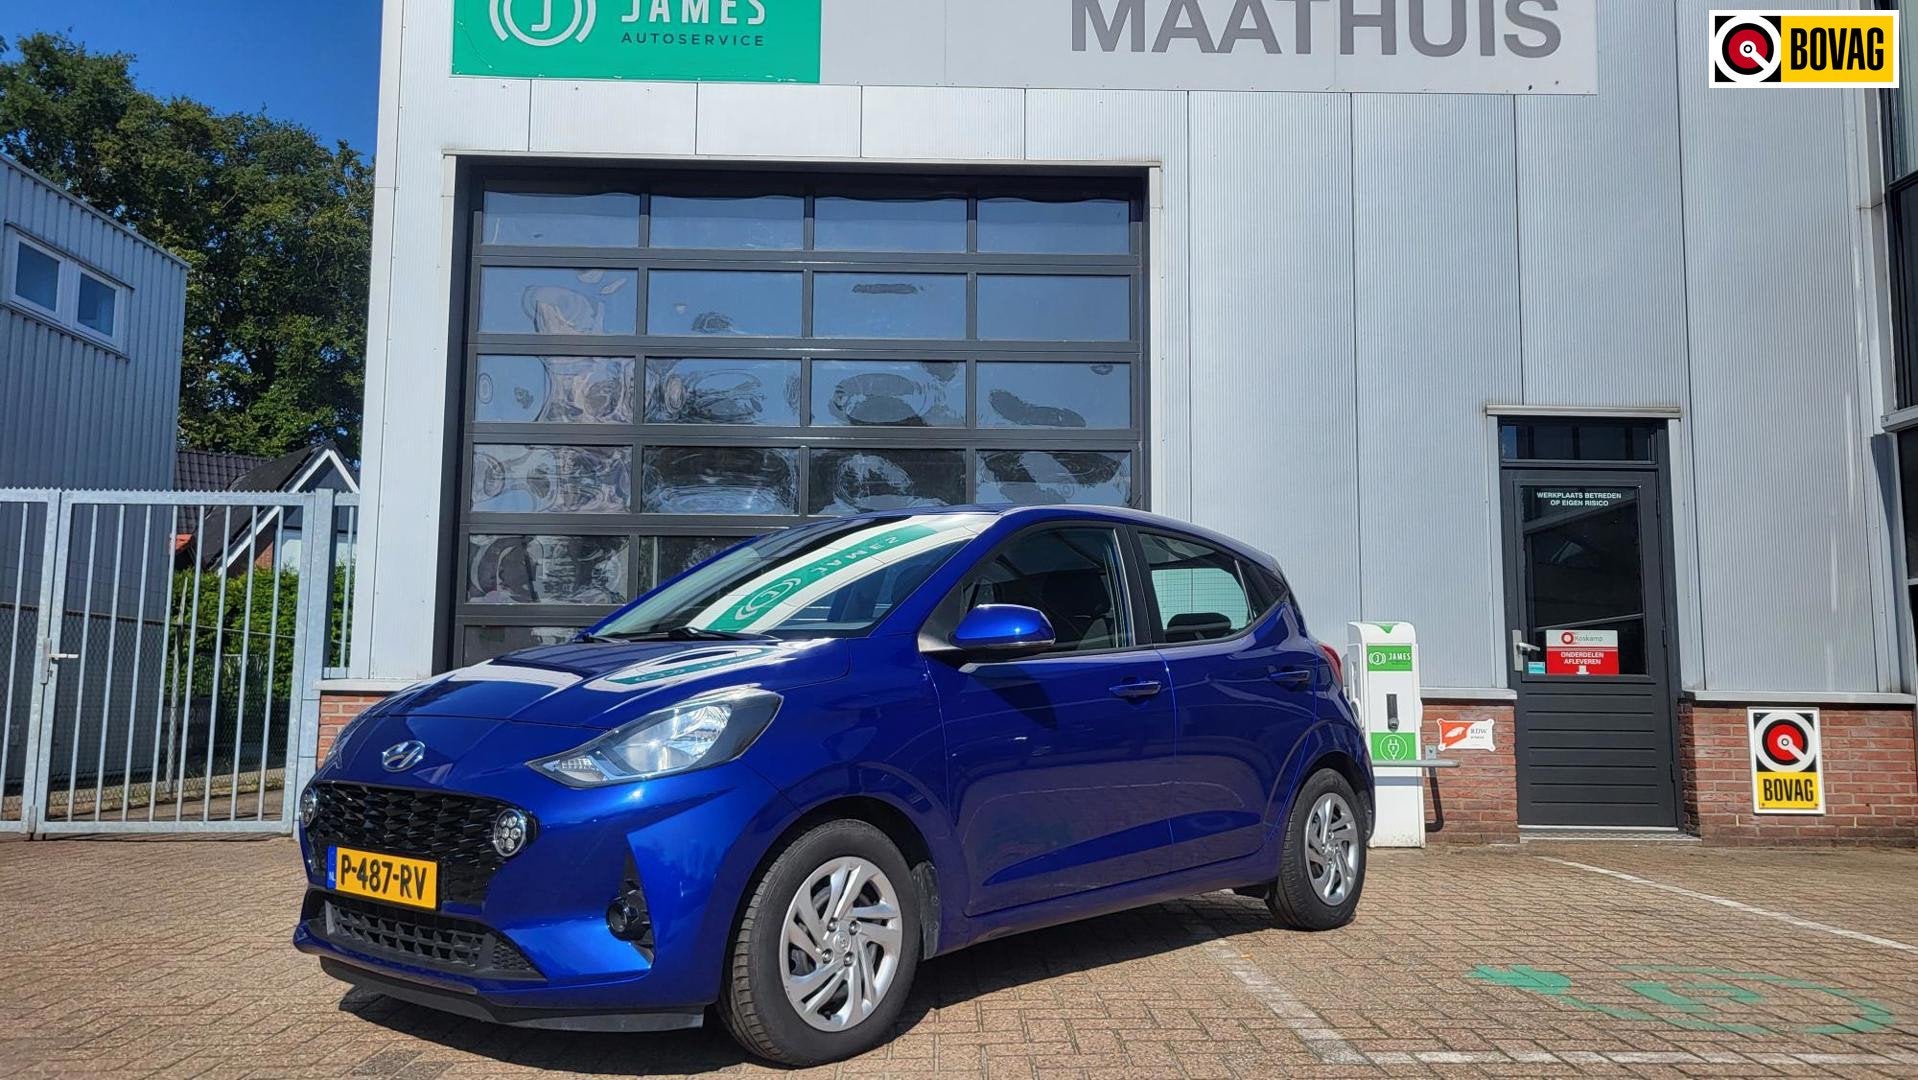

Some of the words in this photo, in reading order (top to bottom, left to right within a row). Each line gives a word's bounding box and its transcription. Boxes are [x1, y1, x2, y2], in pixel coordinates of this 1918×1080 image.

[621, 0, 766, 25] JAMES
[621, 32, 764, 47] AUTOSERVICE
[1071, 0, 1561, 57] MAATHUIS
[1389, 653, 1411, 661] JAMES
[1763, 778, 1814, 802] BOVAG
[341, 854, 427, 900] P-487-RV
